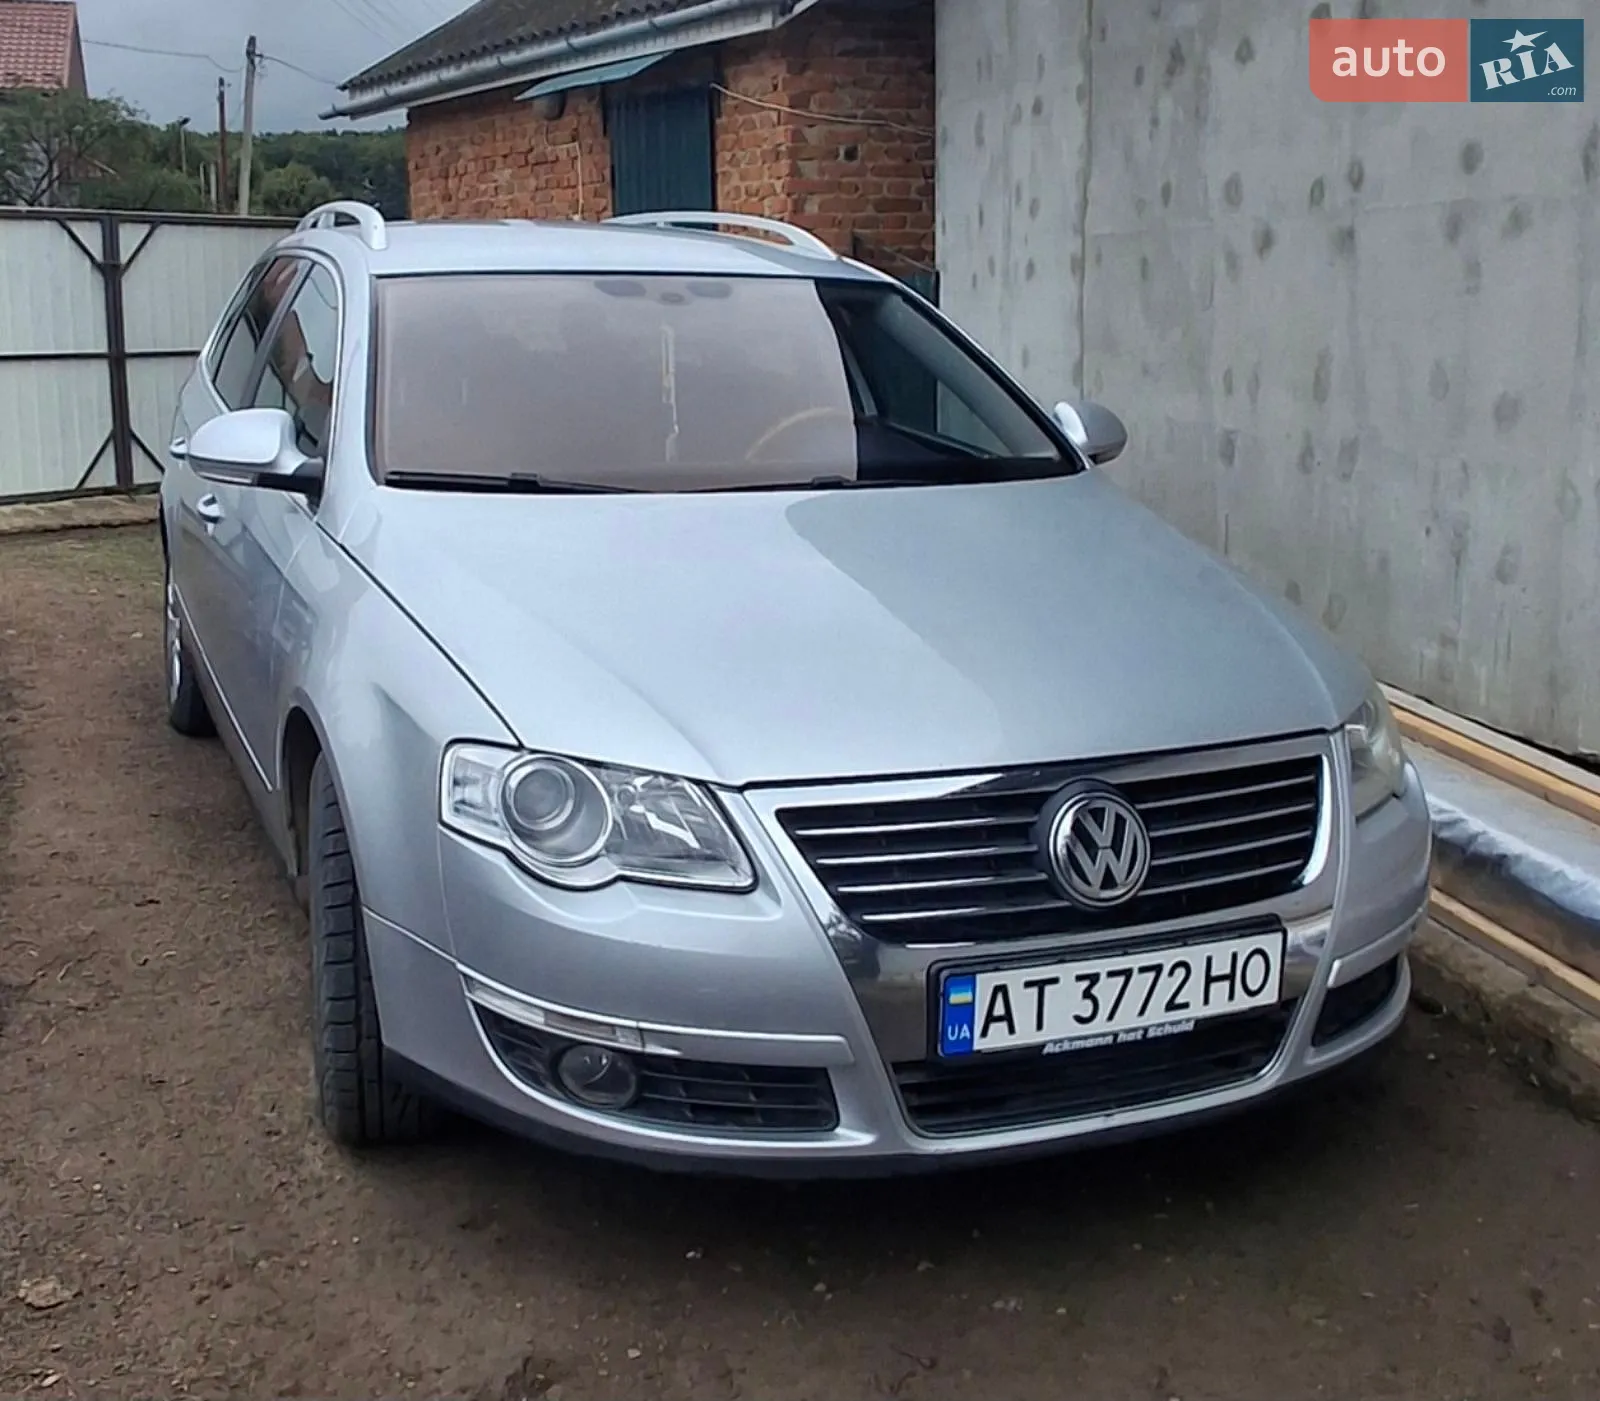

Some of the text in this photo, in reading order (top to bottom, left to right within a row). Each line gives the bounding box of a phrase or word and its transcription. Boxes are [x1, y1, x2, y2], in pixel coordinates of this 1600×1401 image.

[980, 947, 1271, 1039] AT 3772 HO
[948, 1023, 971, 1041] UA
